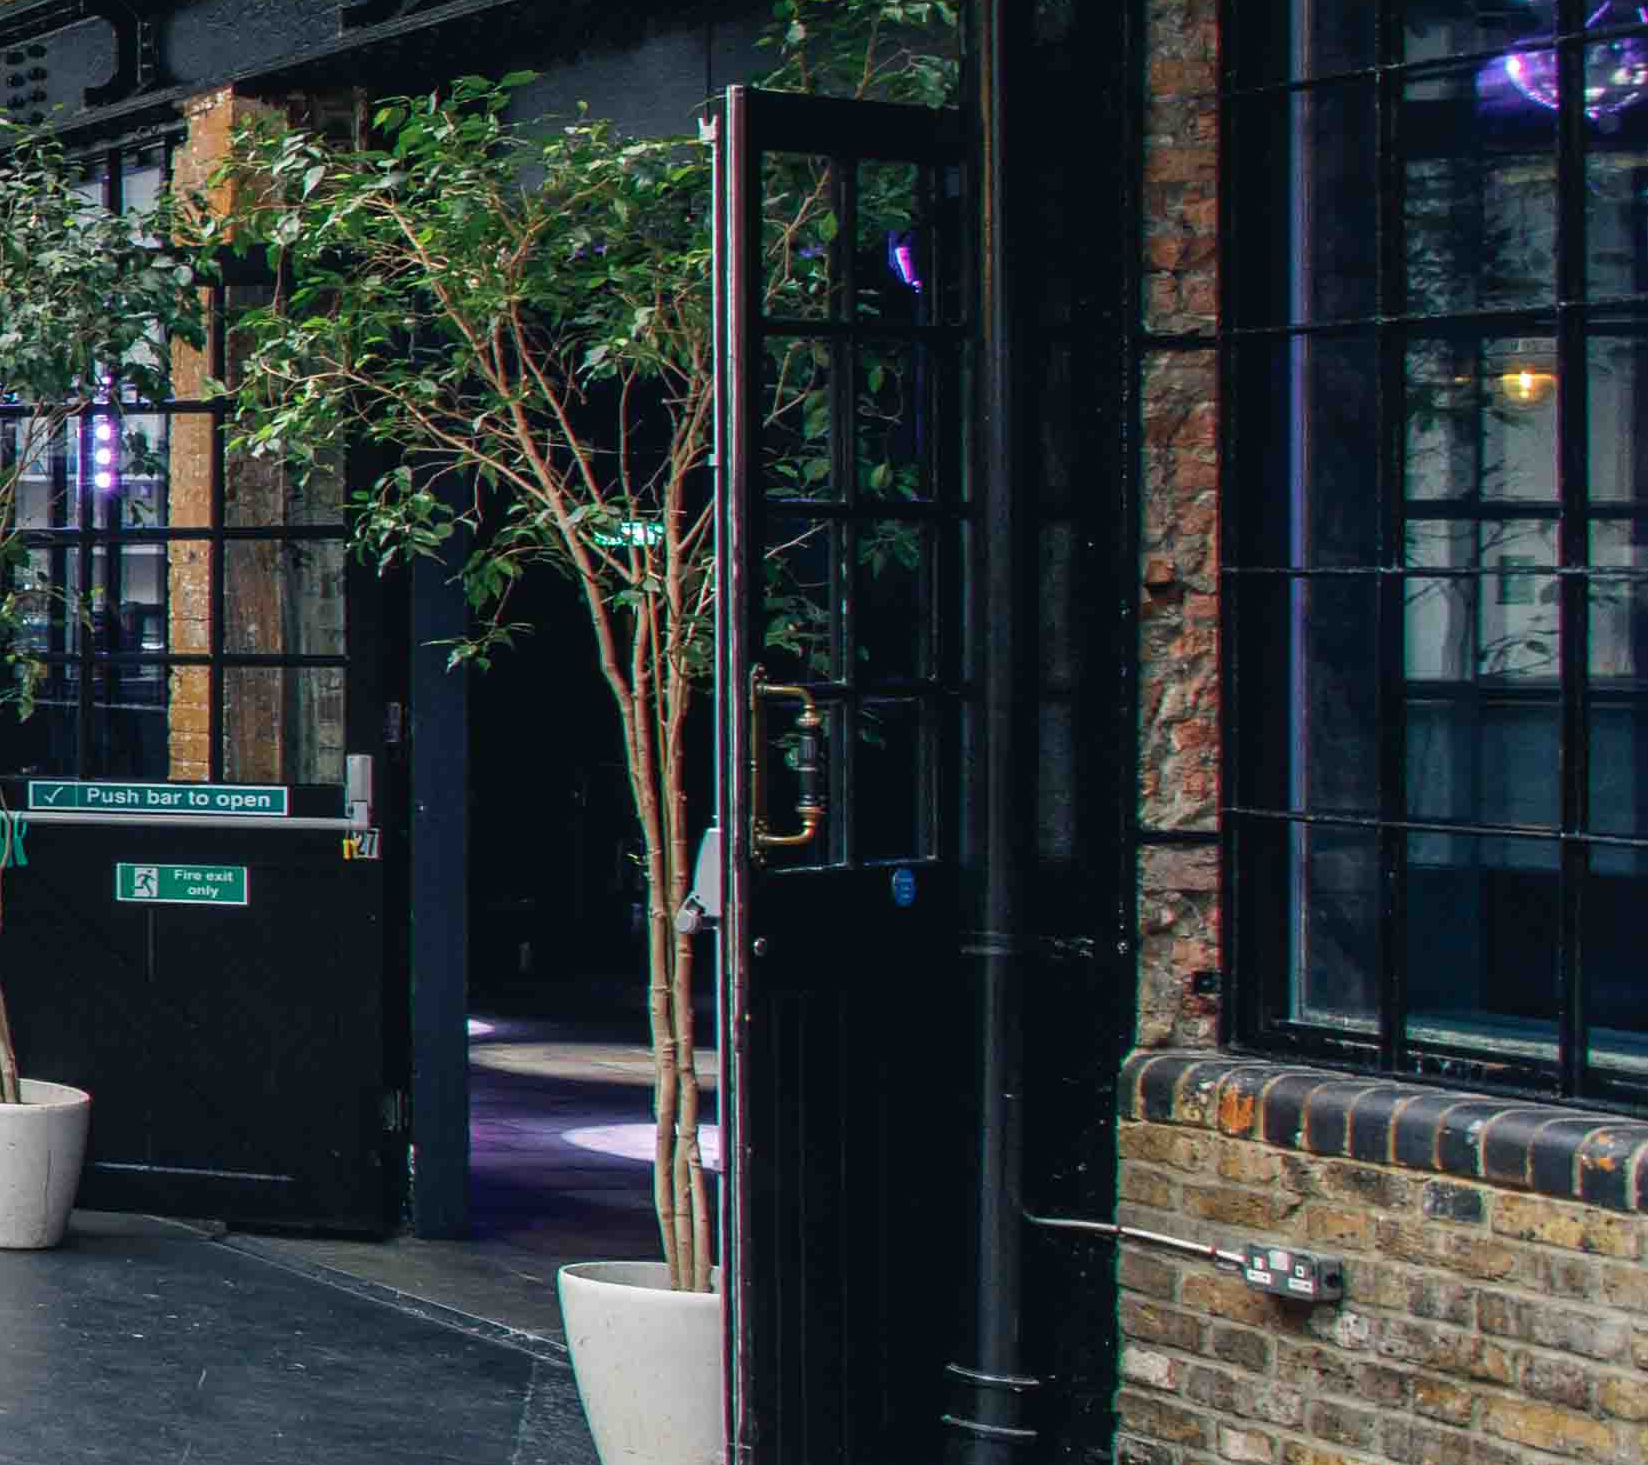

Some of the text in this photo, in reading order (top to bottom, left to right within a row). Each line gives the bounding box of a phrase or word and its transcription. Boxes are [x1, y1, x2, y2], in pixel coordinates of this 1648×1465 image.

[86, 788, 271, 810] Push bar to open
[174, 869, 233, 883] Fire exit
[187, 884, 219, 898] only
